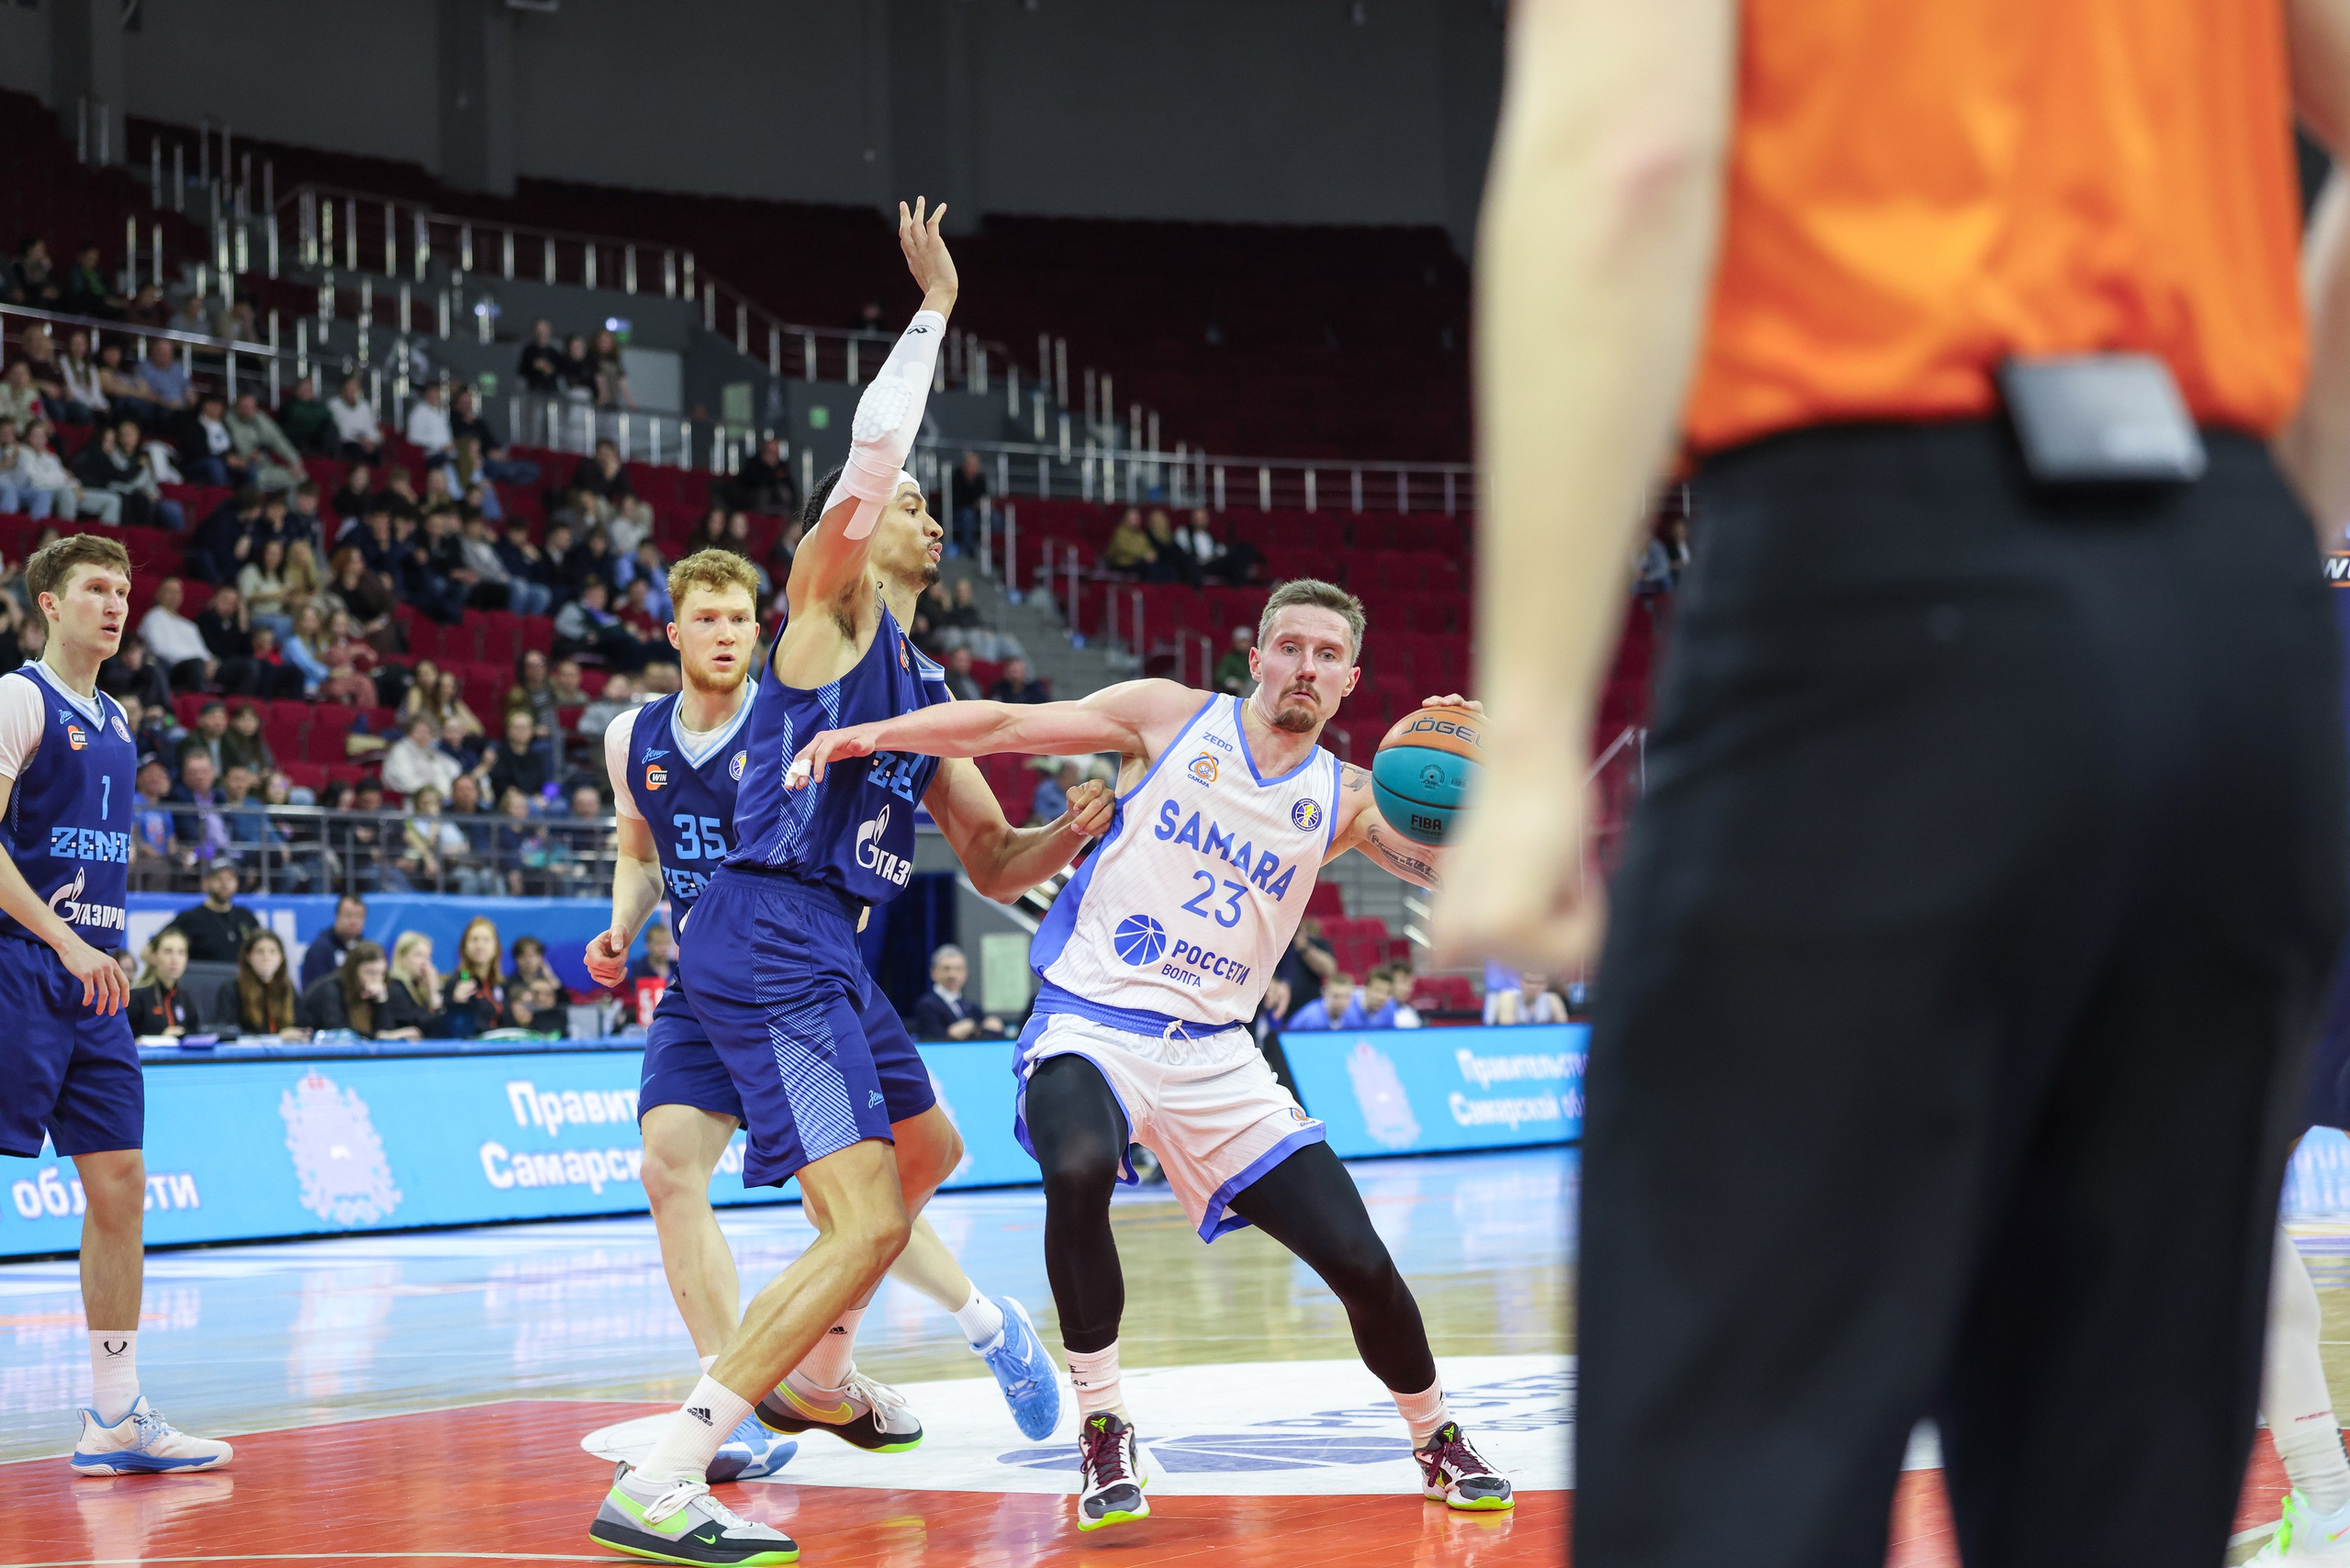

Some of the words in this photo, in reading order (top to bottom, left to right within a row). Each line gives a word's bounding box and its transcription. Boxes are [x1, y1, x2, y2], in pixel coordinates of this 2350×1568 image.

[1203, 732, 1234, 753] ZEDO
[651, 773, 667, 782] WIN
[1187, 773, 1210, 789] САМАРА
[101, 775, 110, 822] 1
[673, 813, 727, 860] 35
[1410, 813, 1442, 831] FIBA
[50, 826, 131, 864] ZENI
[1154, 799, 1298, 902] SAMARA
[876, 849, 913, 889] ГАЗ
[1181, 869, 1248, 928] 23
[1160, 963, 1202, 988] ВОЛГА
[1170, 938, 1251, 986] РОССЕТИ
[687, 1406, 713, 1427] adidas
